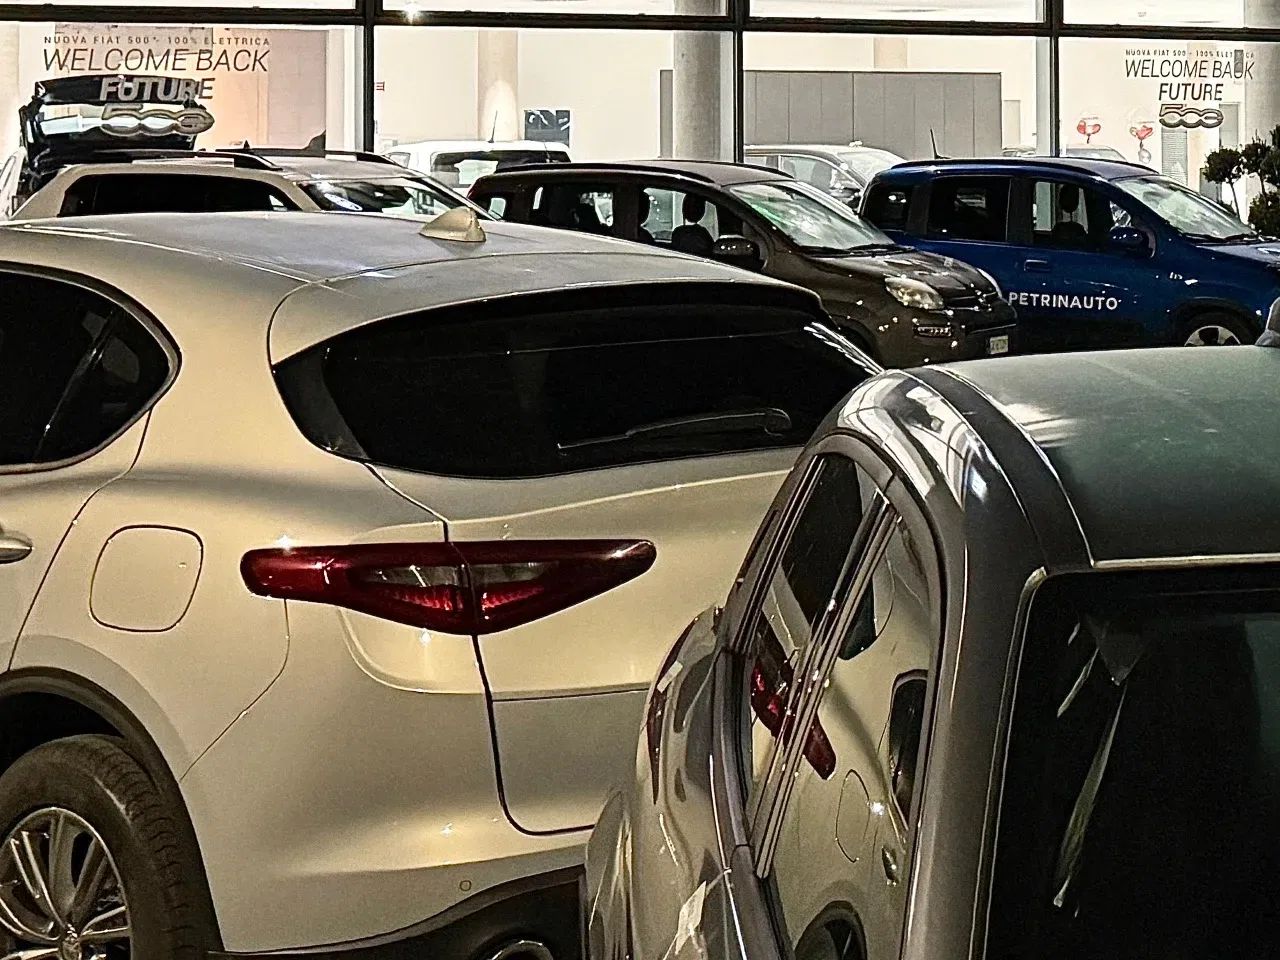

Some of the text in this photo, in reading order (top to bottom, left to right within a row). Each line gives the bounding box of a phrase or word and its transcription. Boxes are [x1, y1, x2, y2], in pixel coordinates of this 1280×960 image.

[44, 36, 87, 44] NUOVA
[93, 36, 120, 44] FIAT
[43, 48, 270, 72] WELCOME BACK
[1125, 59, 1209, 78] WELCOME
[100, 77, 216, 101] FUTURE
[1158, 83, 1224, 101] FUTURE
[1008, 291, 1119, 311] PETRINAUTO
